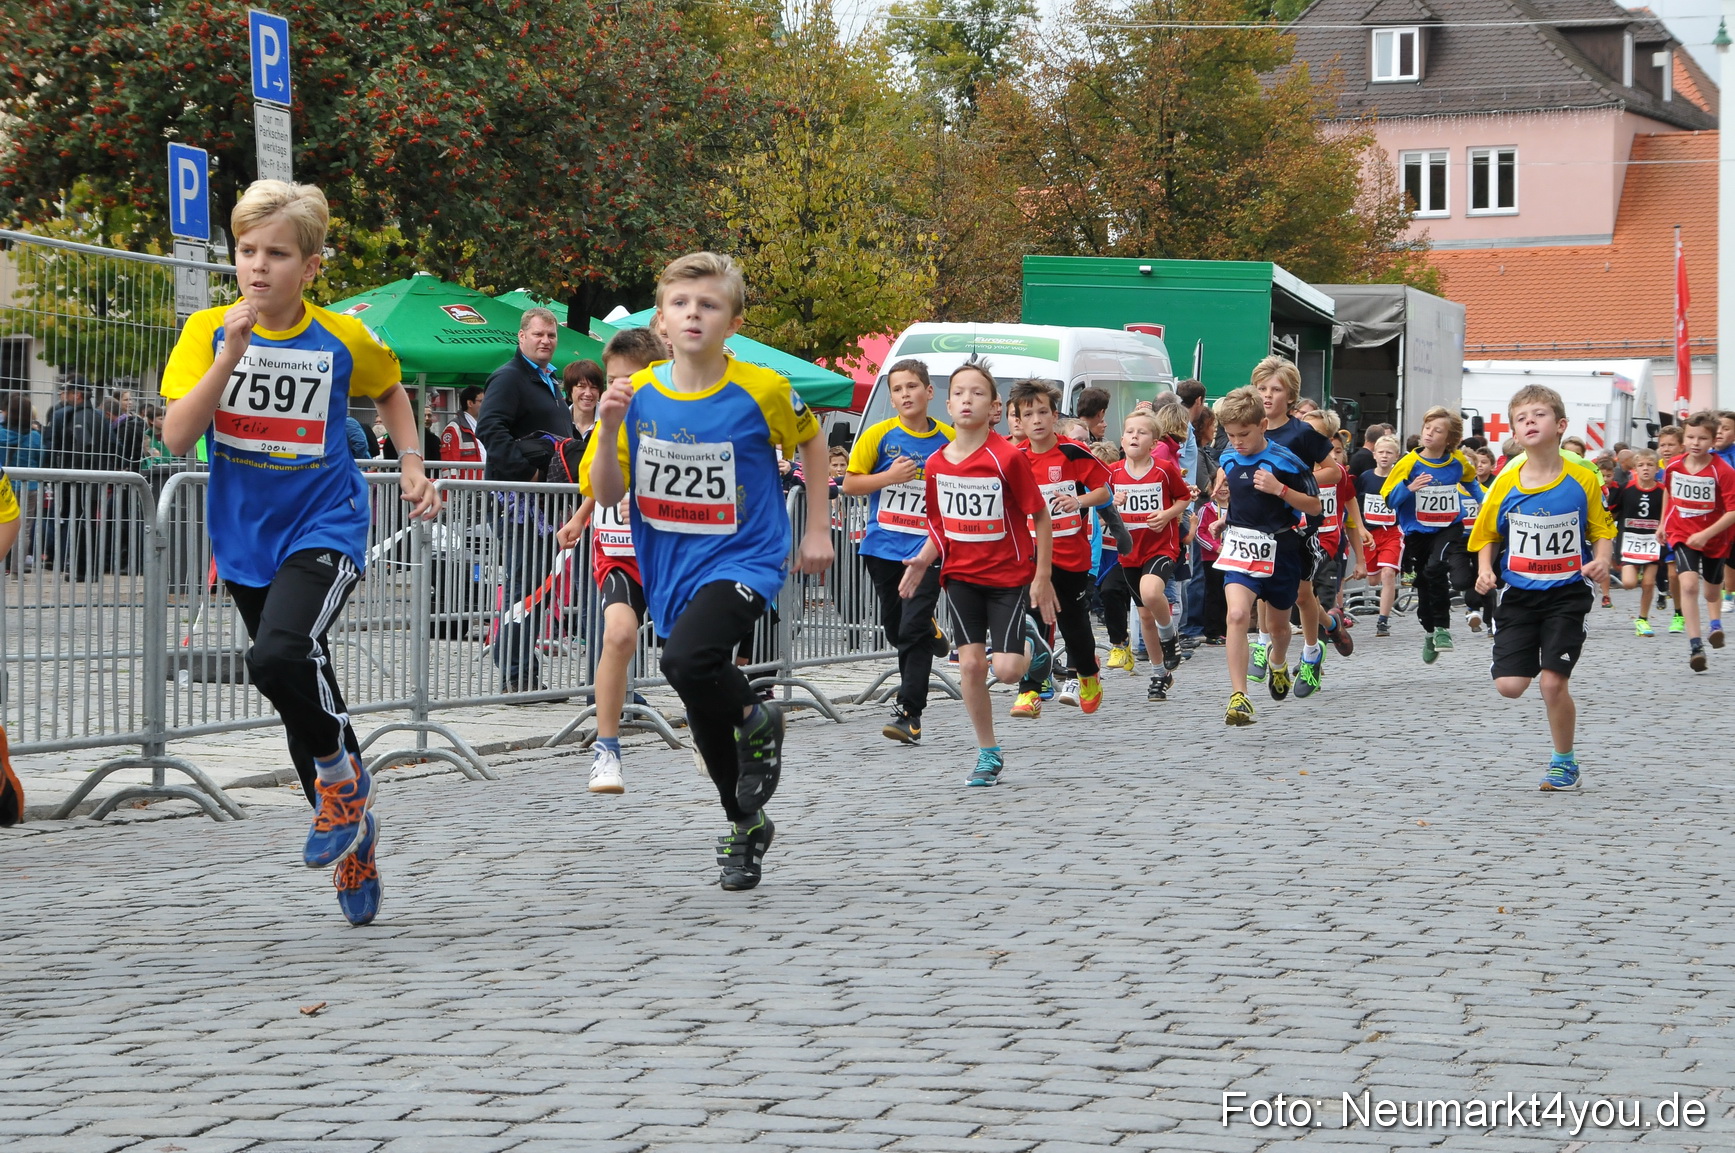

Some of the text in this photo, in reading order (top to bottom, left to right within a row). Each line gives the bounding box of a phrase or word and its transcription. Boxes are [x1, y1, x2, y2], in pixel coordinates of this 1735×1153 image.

[259, 24, 280, 89] P
[259, 124, 289, 141] Parkschein
[262, 142, 287, 157] werktags
[178, 157, 199, 225] P
[433, 335, 520, 346] Lammsb
[441, 328, 519, 338] Neumarkte
[974, 336, 1025, 344] Europcar
[258, 357, 313, 371] Neumarkt
[227, 370, 322, 414] 7597
[231, 416, 269, 434] Felix
[639, 443, 716, 461] PARTL Neumarkt
[644, 459, 726, 500] 7225
[938, 480, 990, 491] PARTL Neumarkt
[1675, 482, 1711, 500] 7098
[943, 491, 996, 517] 7037
[1420, 495, 1455, 511] 7201
[1637, 501, 1650, 517] 3
[658, 503, 710, 521] Michael
[892, 515, 919, 527] Marcel
[958, 522, 981, 532] Lauri
[1510, 519, 1569, 530] PARTL Neumarkt
[1229, 539, 1272, 560] 7598
[1516, 529, 1575, 556] 7142
[1627, 540, 1657, 554] 7512
[1528, 561, 1562, 572] Marius
